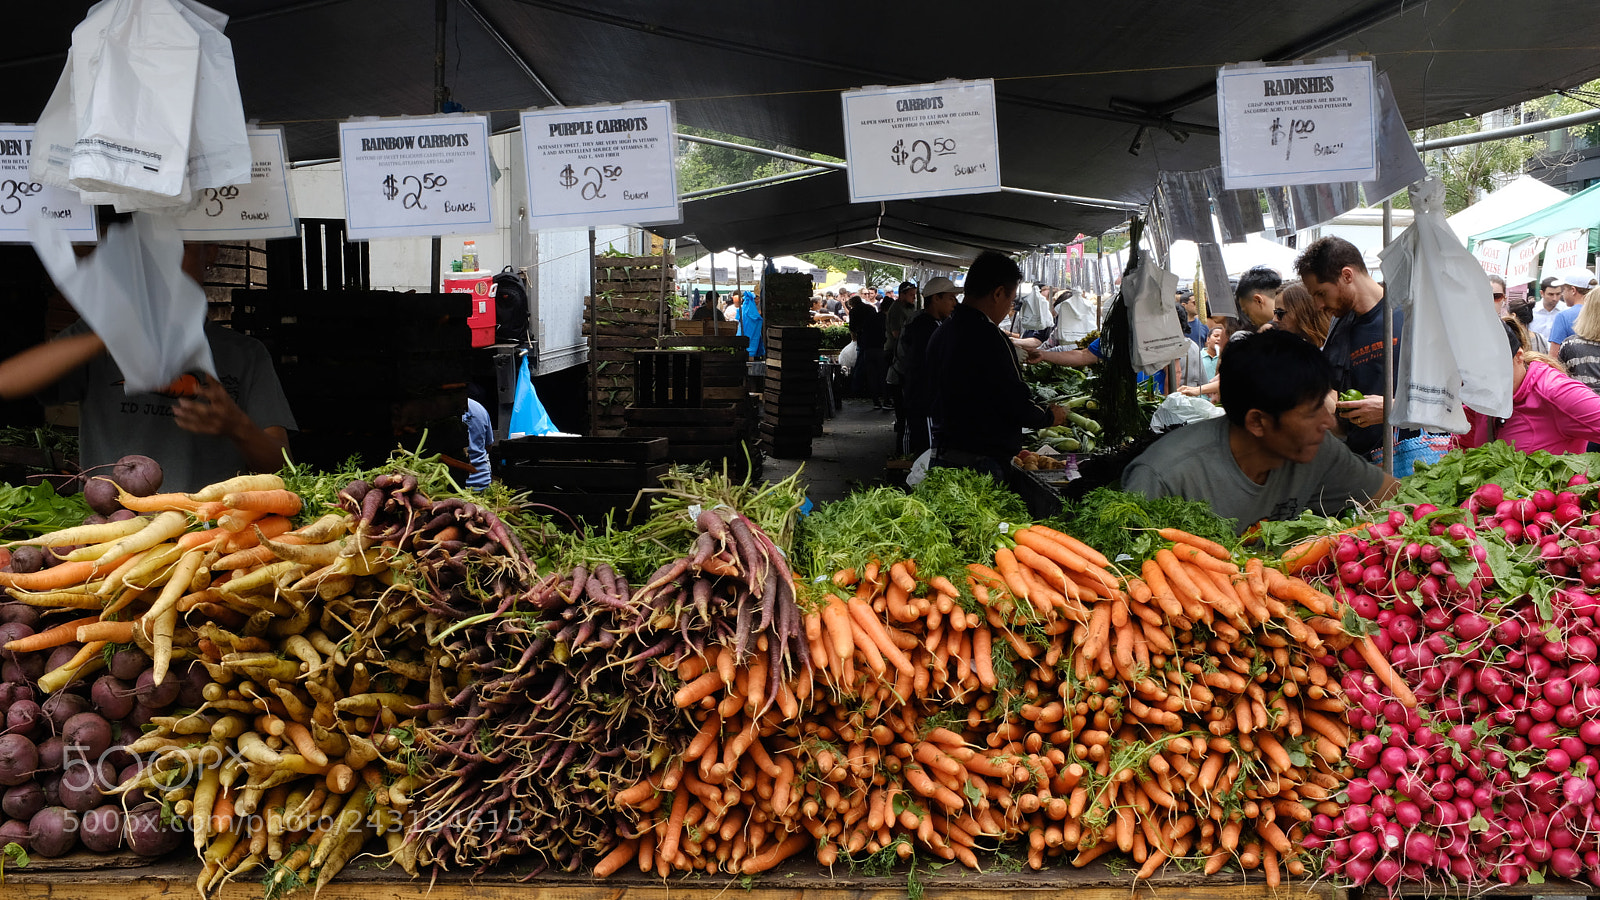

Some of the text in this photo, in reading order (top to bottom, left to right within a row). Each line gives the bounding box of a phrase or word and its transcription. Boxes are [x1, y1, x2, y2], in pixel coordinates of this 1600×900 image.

[1264, 76, 1334, 96] RADISHES
[896, 96, 944, 112] CARROTS
[549, 117, 648, 137] PURPLE CARROTS
[362, 133, 469, 151] RAINBOW CARROTS
[141, 150, 162, 160] recycling
[624, 190, 648, 200] BUNCH
[444, 201, 476, 213] BUNCH
[241, 211, 269, 220] BUNCH
[1483, 247, 1500, 260] GOAT
[1520, 247, 1535, 260] GOA
[1557, 239, 1578, 254] GOAT
[1480, 260, 1501, 274] HEESE
[1555, 255, 1578, 270] MEAT
[120, 402, 177, 418] I'D JUIC
